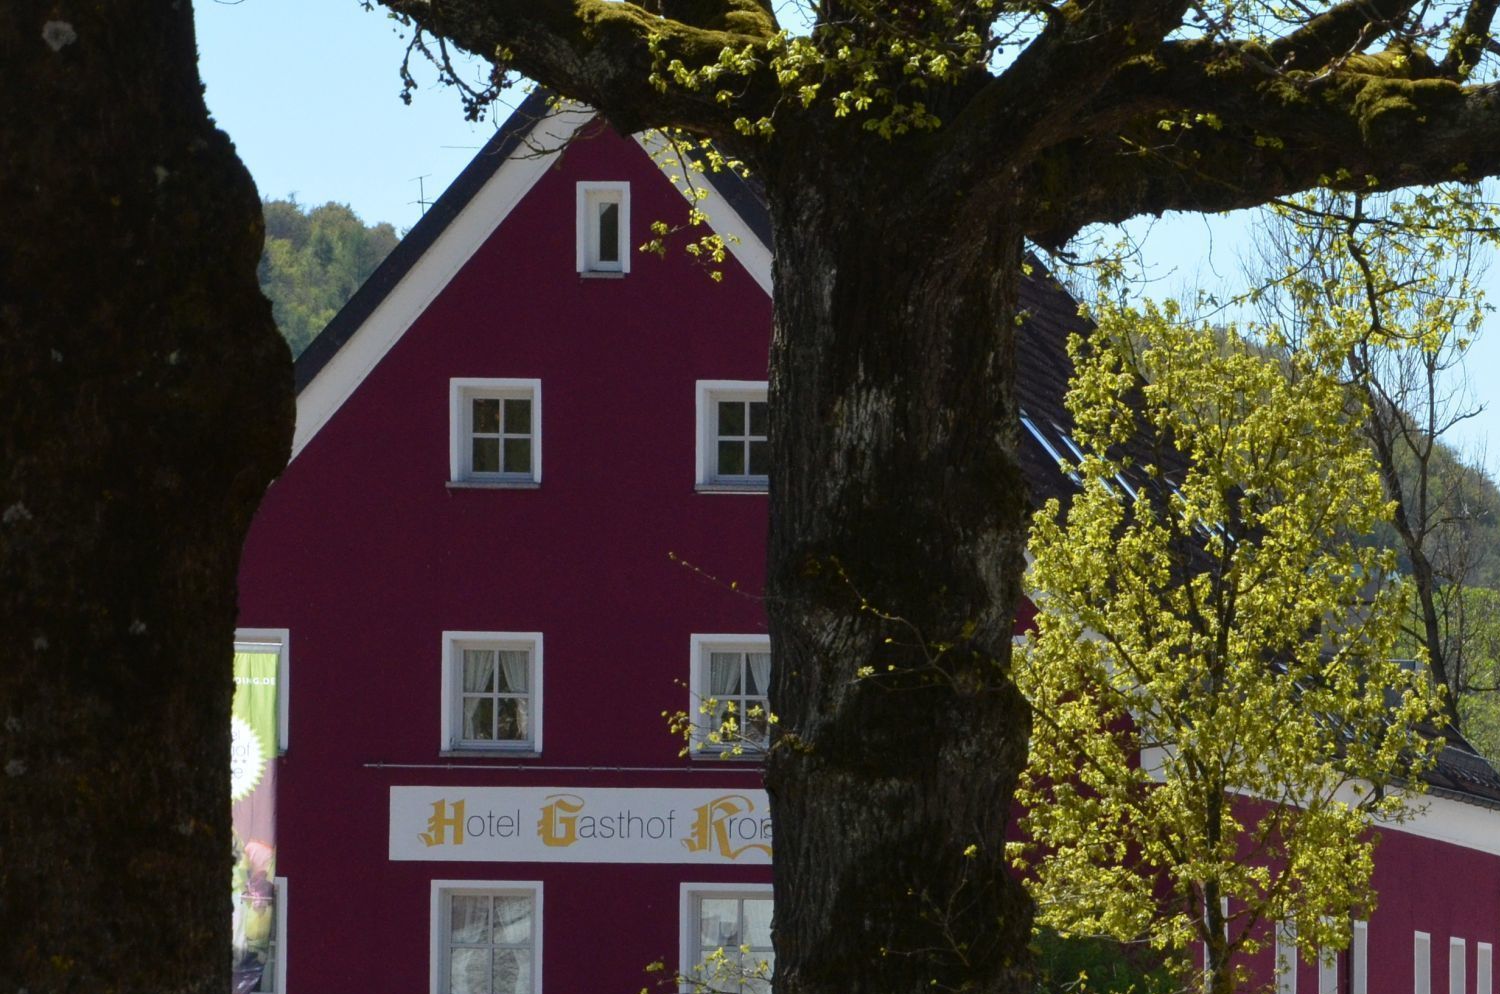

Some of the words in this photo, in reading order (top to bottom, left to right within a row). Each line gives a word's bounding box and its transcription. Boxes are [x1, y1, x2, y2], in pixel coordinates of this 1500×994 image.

[418, 798, 520, 847] Hotel
[537, 793, 676, 847] Gasthof
[680, 794, 772, 860] Kron
